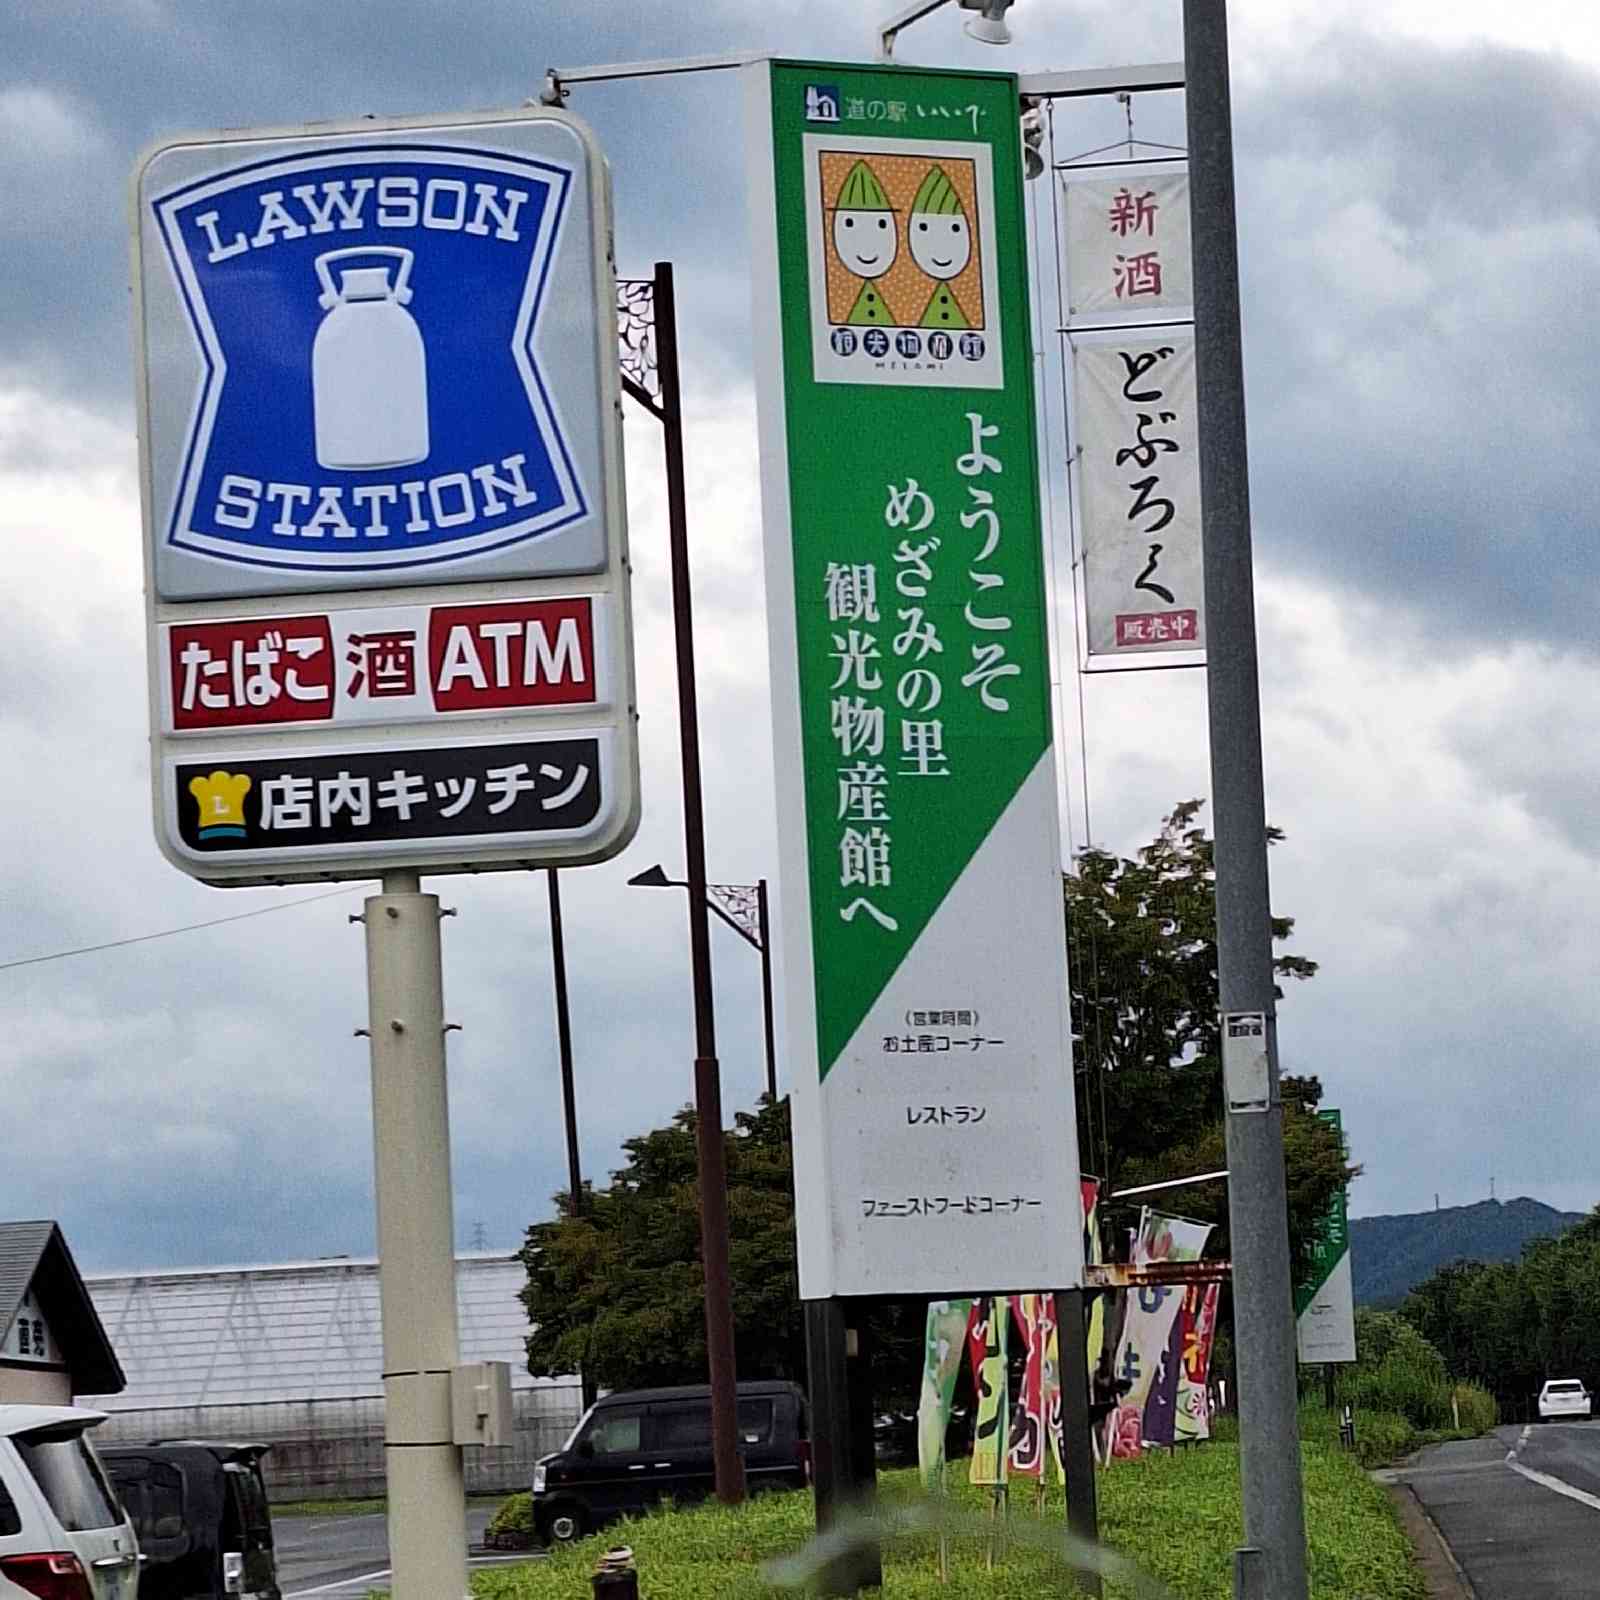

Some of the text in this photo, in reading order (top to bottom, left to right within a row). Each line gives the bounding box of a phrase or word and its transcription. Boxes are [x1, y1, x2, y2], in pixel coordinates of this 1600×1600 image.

[846, 97, 908, 122] 道の駅
[195, 177, 529, 263] LAWSON
[1109, 187, 1161, 298] 新酒
[214, 453, 538, 538] STATION
[1116, 346, 1180, 604] どぶろく
[956, 412, 1022, 712] ようこそ
[180, 617, 586, 711] たばこ 酒 ATM
[884, 477, 951, 777] めざみの里
[823, 560, 899, 932] 観光物産館へ
[258, 761, 590, 831] 店内キッチン
[883, 1034, 1005, 1052] お土産コーナー
[907, 1106, 986, 1124] レストラン
